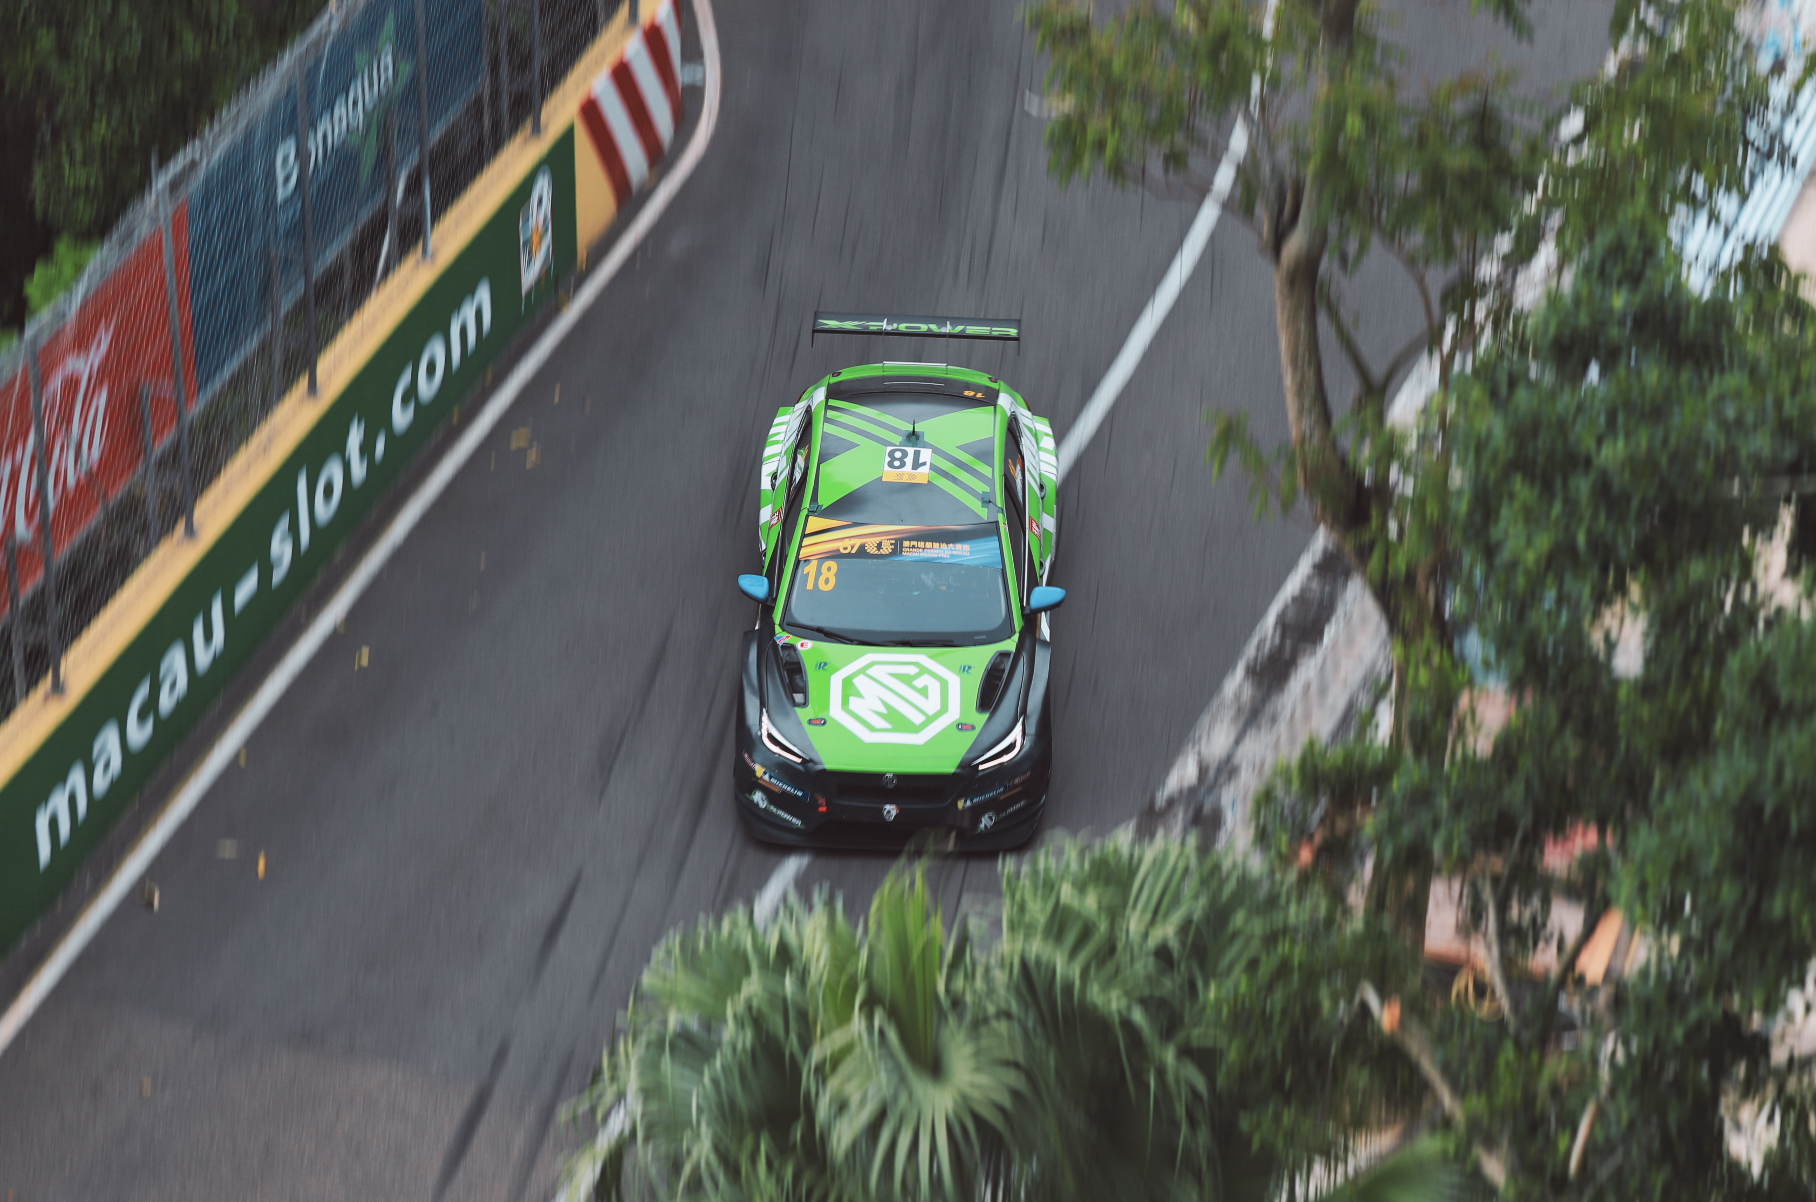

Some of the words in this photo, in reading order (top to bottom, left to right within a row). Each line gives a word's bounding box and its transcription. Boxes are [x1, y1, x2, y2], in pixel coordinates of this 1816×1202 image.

[963, 390, 985, 398] 18
[887, 448, 927, 471] 18
[803, 560, 838, 592] 18
[849, 665, 941, 729] MG
[770, 777, 804, 797] MICHELIN
